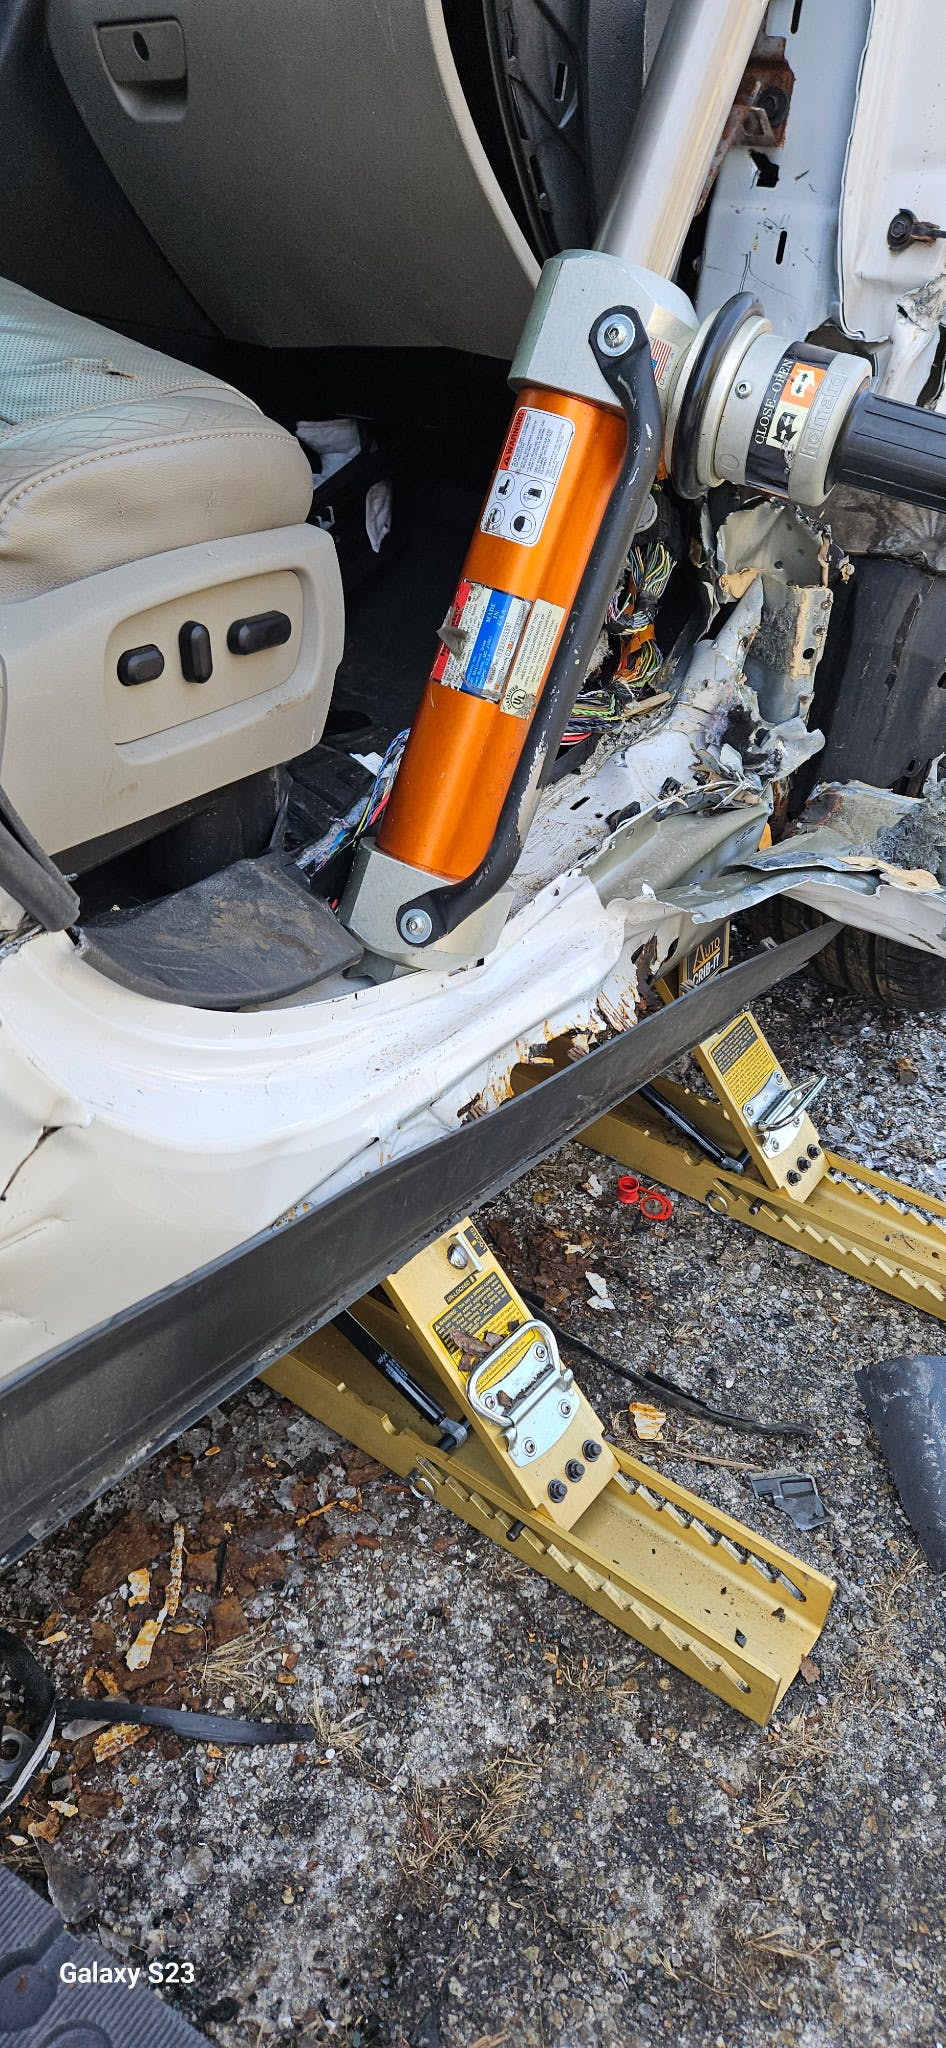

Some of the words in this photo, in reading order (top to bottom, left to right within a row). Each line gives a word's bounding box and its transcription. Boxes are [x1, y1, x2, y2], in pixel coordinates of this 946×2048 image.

[755, 398, 776, 444] CLOSE
[772, 359, 794, 392] OPEN
[506, 411, 524, 454] WARNING
[513, 692, 525, 705] UL
